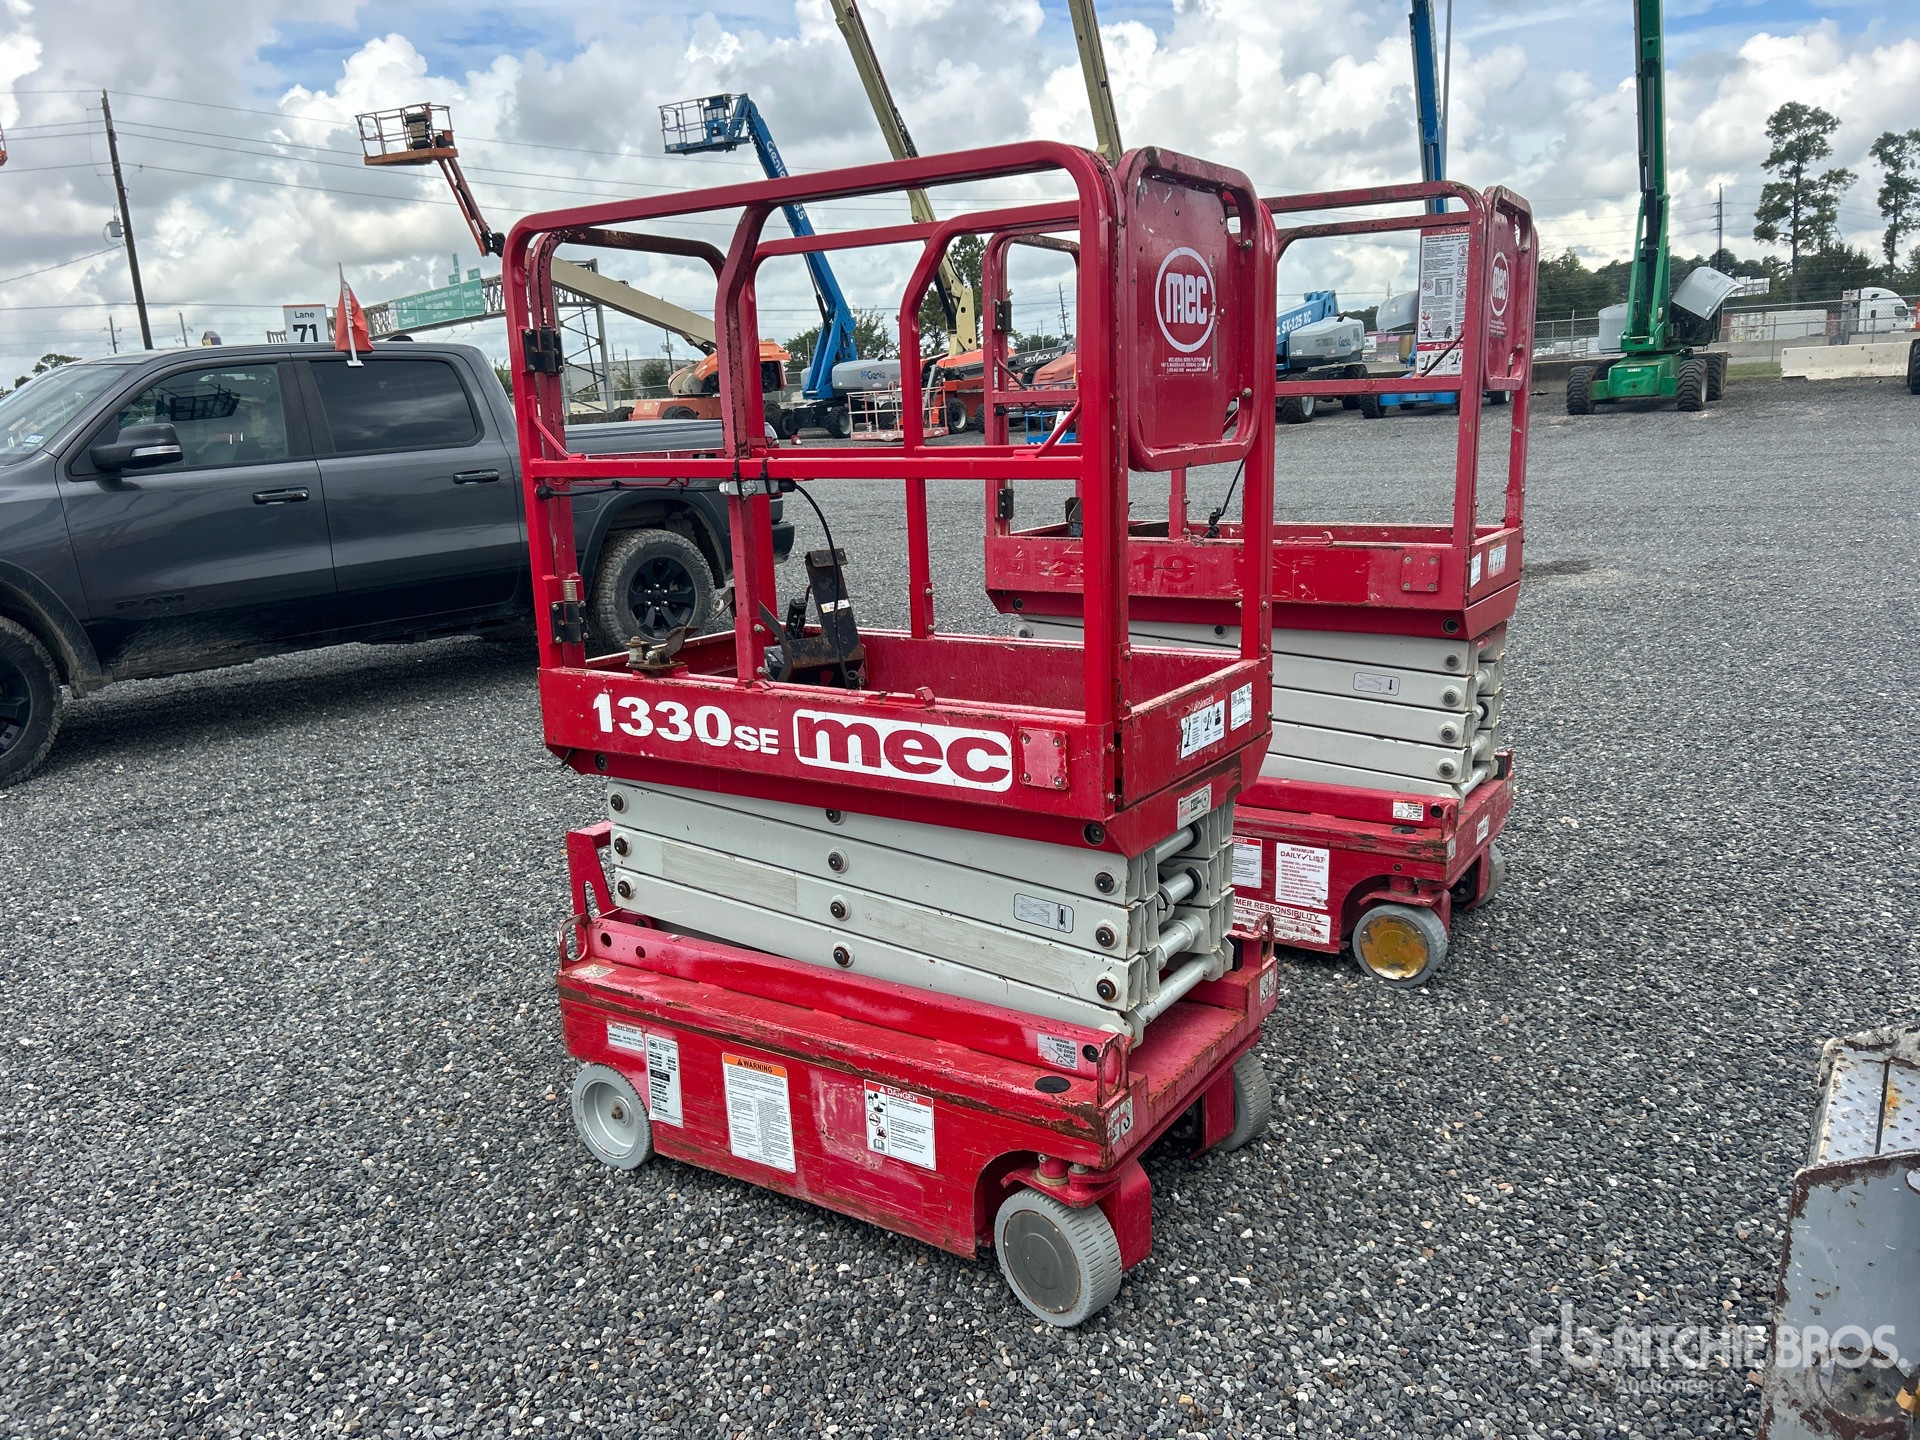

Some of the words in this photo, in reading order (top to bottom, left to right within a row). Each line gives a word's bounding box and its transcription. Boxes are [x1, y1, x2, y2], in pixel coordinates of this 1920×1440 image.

[1165, 272, 1208, 325] mec
[294, 310, 315, 319] Lane
[1281, 315, 1303, 335] SX-125
[1303, 310, 1312, 325] XC
[292, 323, 319, 343] 71
[1024, 351, 1051, 363] SKYJACK
[867, 370, 886, 380] Genie
[115, 592, 185, 609] RAM
[797, 715, 1010, 783] mec
[1280, 851, 1301, 859] DAILY
[1308, 855, 1325, 863] LIST
[1234, 898, 1253, 908] MER
[1254, 902, 1320, 921] RESPONSIBILITY
[1284, 919, 1316, 929] LUBRICATION
[744, 1061, 773, 1074] WARNING
